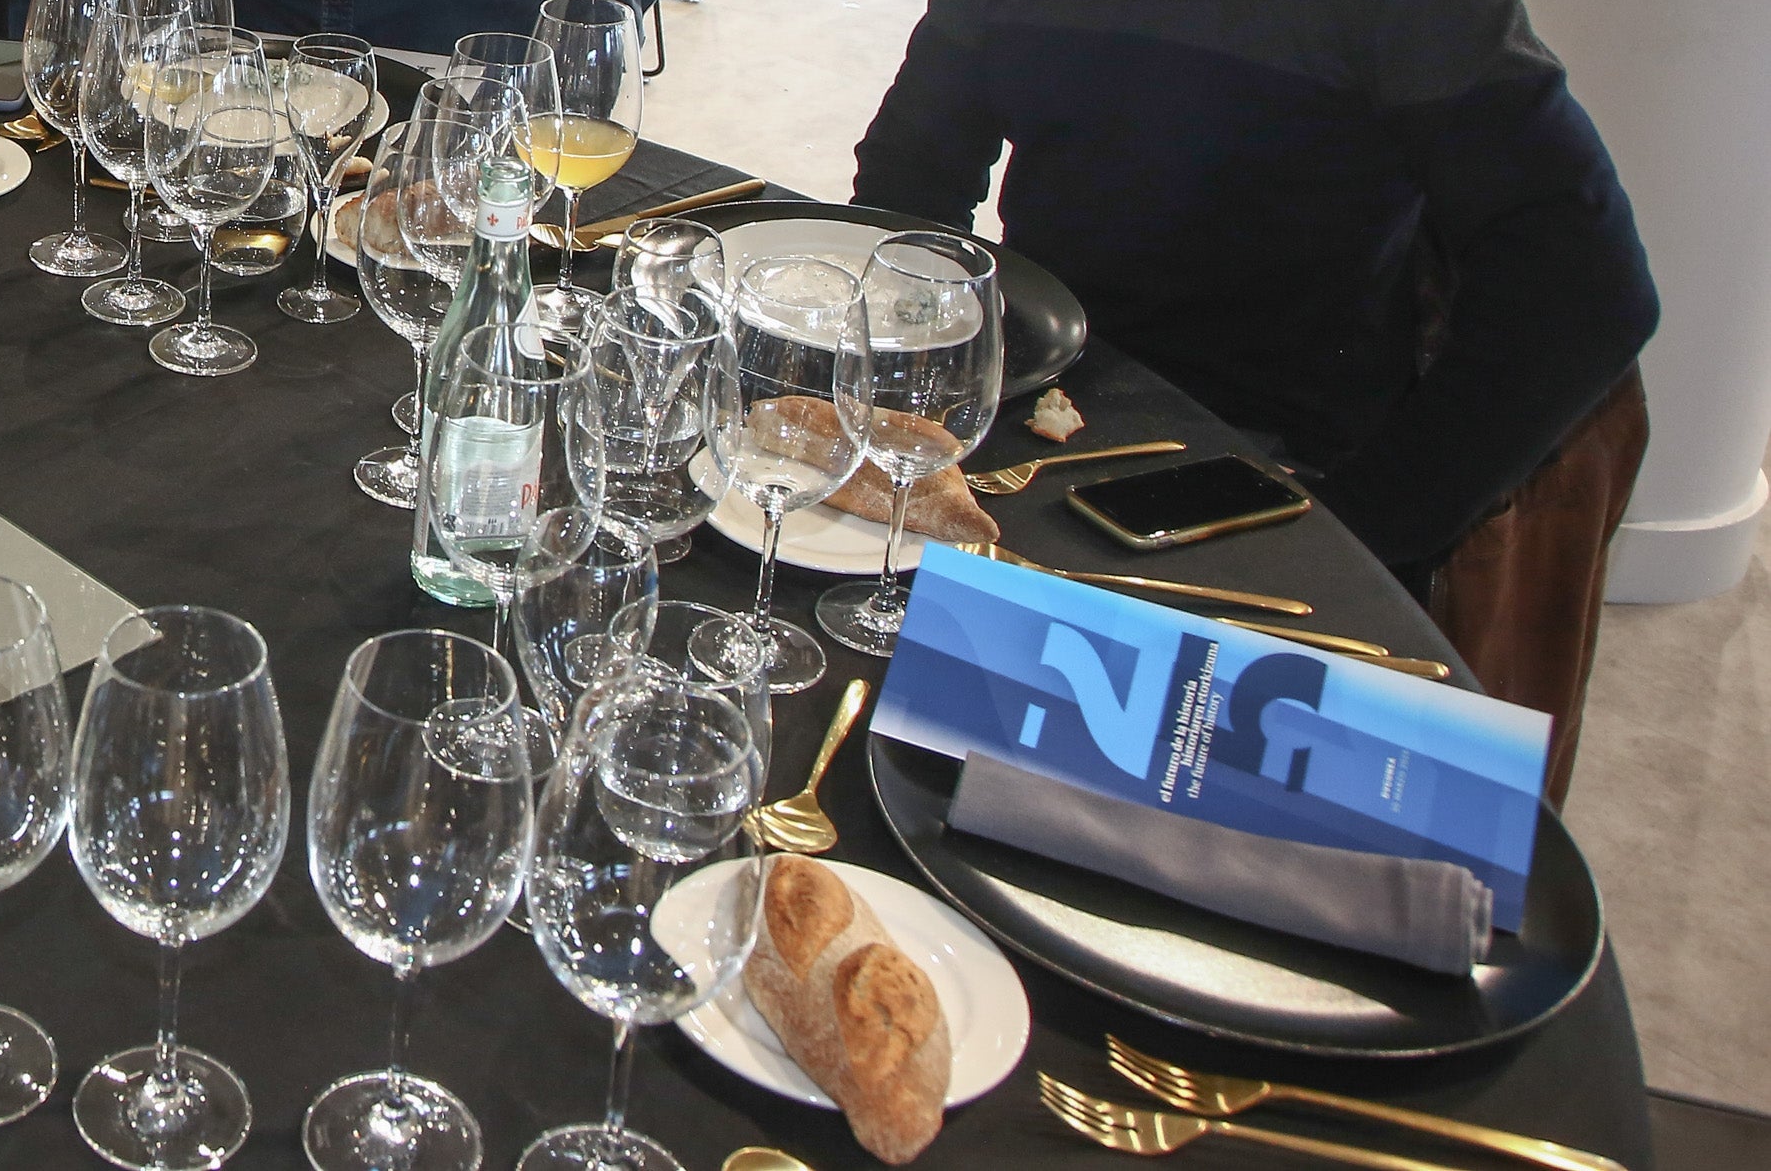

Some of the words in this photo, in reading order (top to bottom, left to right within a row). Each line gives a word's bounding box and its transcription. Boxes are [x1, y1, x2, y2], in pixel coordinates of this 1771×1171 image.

[1176, 679, 1198, 725] historia
[1180, 704, 1206, 768] historiaren
[1196, 642, 1220, 705] etorkizuna
[1202, 691, 1225, 731] history
[1170, 736, 1184, 753] de
[1201, 728, 1213, 745] of
[1161, 752, 1180, 791] futuro
[1190, 744, 1210, 779] future
[1159, 789, 1172, 804] el
[1186, 777, 1203, 799] the
